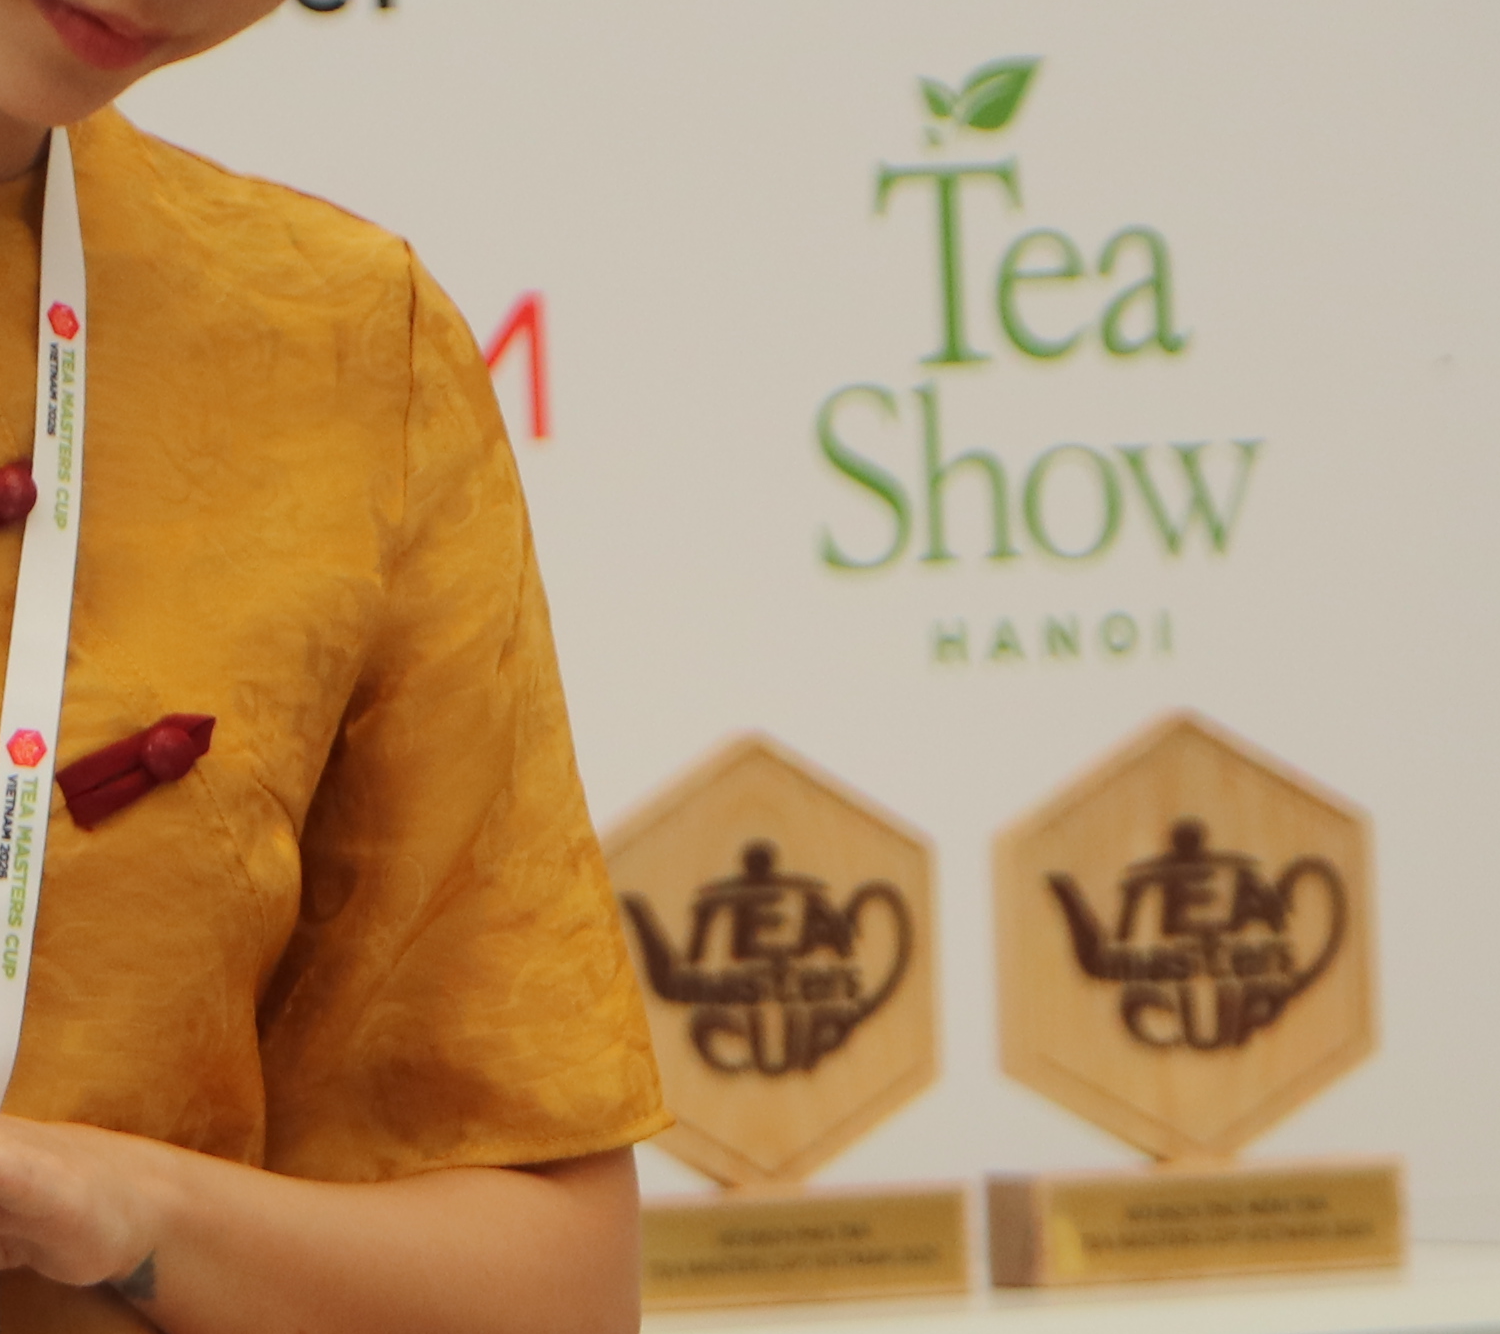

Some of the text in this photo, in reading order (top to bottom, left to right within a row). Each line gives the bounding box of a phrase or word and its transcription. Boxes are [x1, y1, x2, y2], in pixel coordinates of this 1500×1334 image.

[873, 157, 1192, 365] Tea
[49, 342, 59, 400] VIETNAM
[54, 348, 75, 530] TEA MASTERS CUP
[814, 380, 1265, 571] Show
[930, 609, 1174, 664] HANOI
[2, 774, 19, 840] VIETNAM
[2, 776, 38, 980] TEA MASTERS CUP
